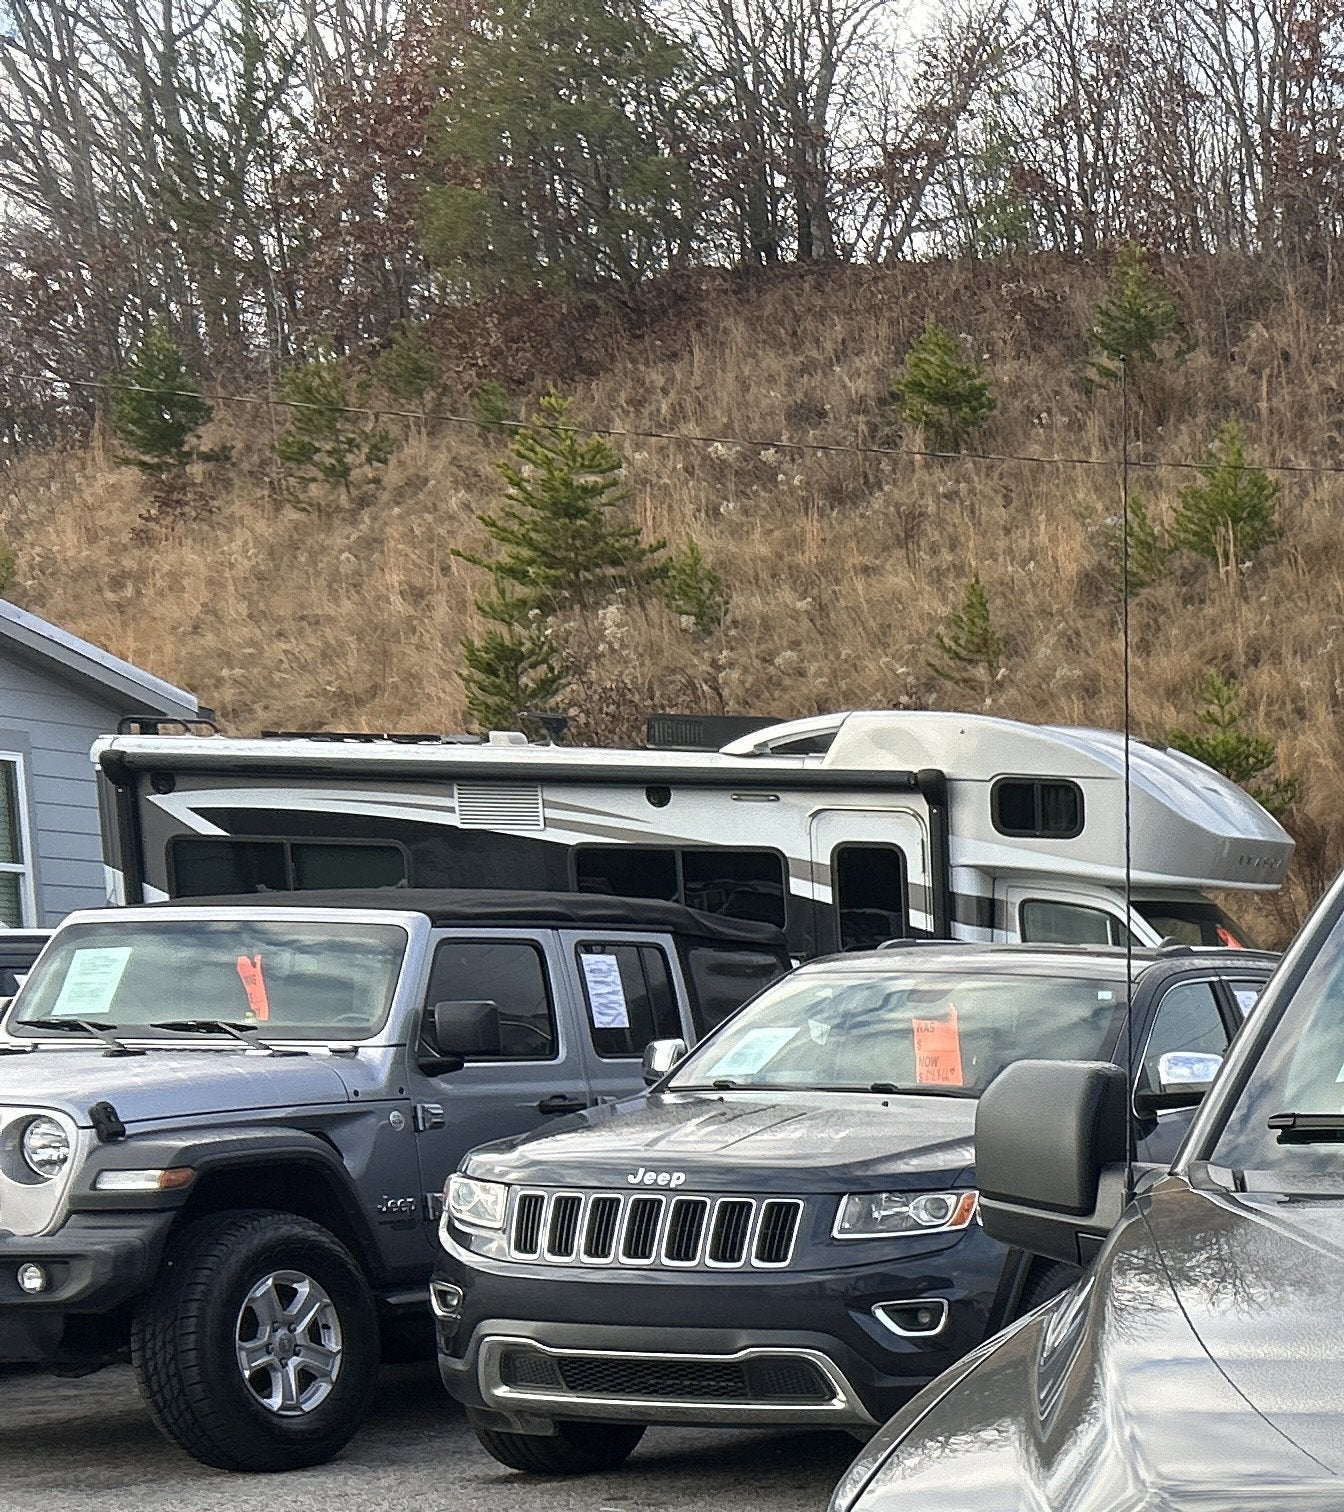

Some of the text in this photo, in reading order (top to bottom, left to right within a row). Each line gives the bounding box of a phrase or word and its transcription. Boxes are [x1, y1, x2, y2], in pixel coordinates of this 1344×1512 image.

[916, 1022, 936, 1033] WAS
[919, 1055, 940, 1068] NOW
[627, 1167, 686, 1188] Jeep
